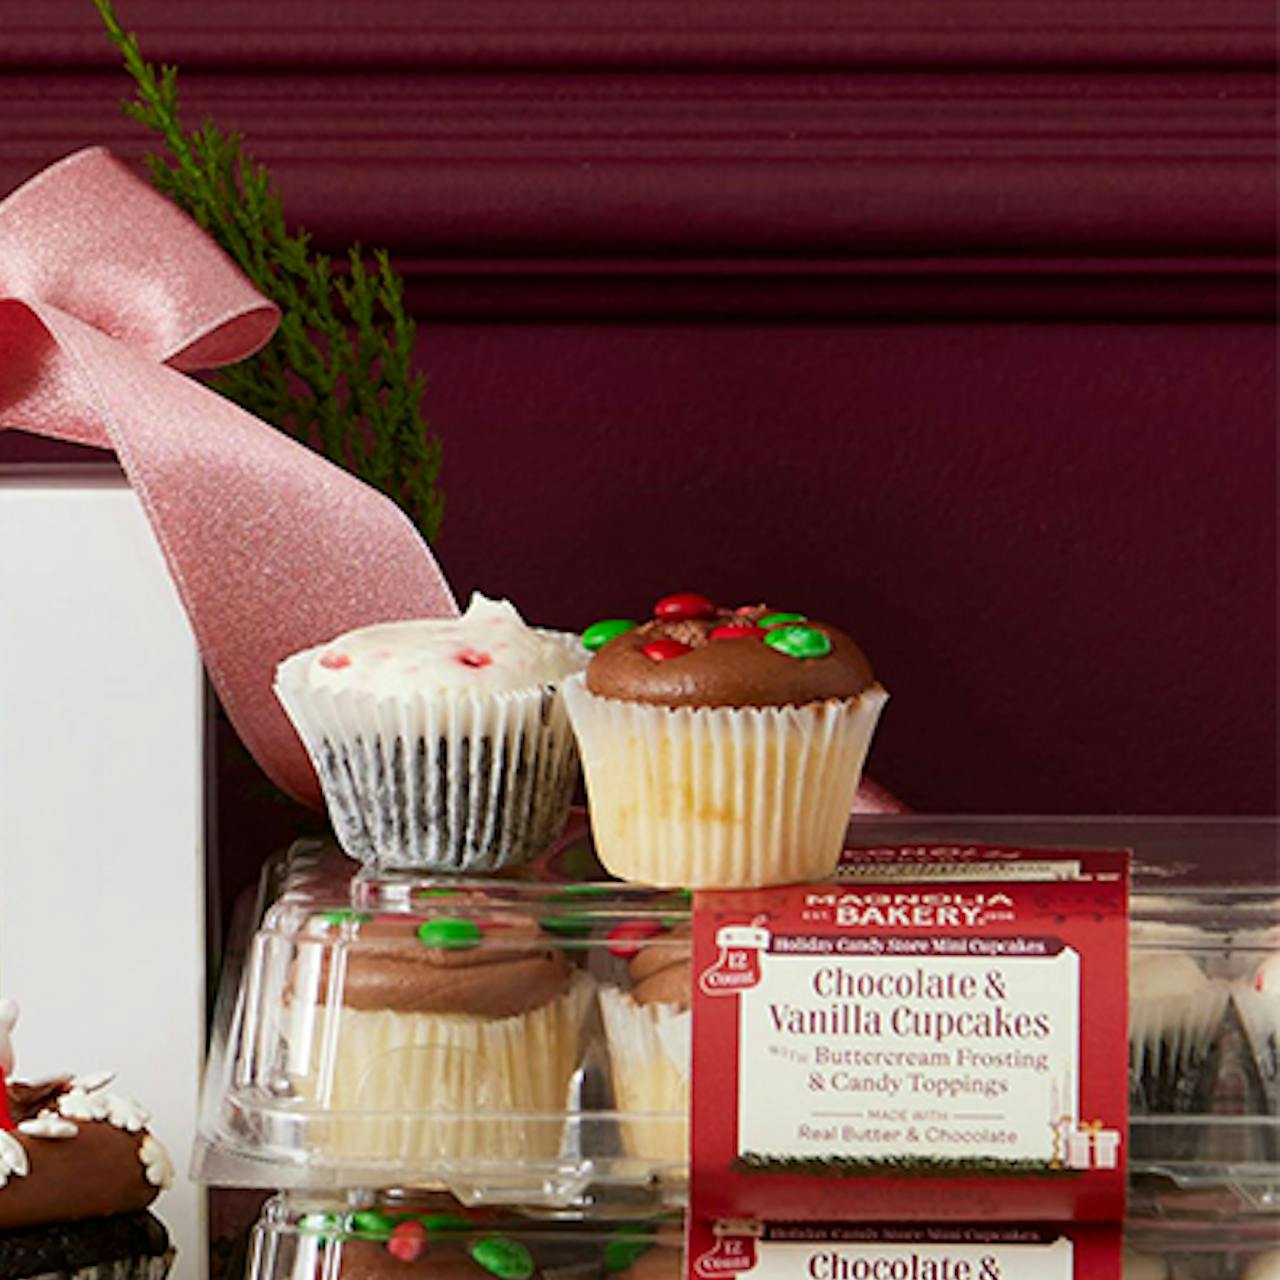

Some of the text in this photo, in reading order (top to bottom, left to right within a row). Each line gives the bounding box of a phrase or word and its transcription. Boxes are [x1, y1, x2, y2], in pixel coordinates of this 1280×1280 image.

[774, 935, 833, 954] Holiday
[836, 936, 884, 955] Candy
[969, 937, 1046, 955] Cupcakes
[727, 951, 747, 968] 12
[812, 966, 1007, 998] Chocolate &
[768, 1003, 1051, 1042] Vanilla Cupcakes
[814, 1045, 951, 1067] Buttercream
[956, 1048, 1050, 1072] Frosting
[807, 1072, 1009, 1098] & Candy Toppings
[798, 1123, 1019, 1145] Real Butter & Chocolate
